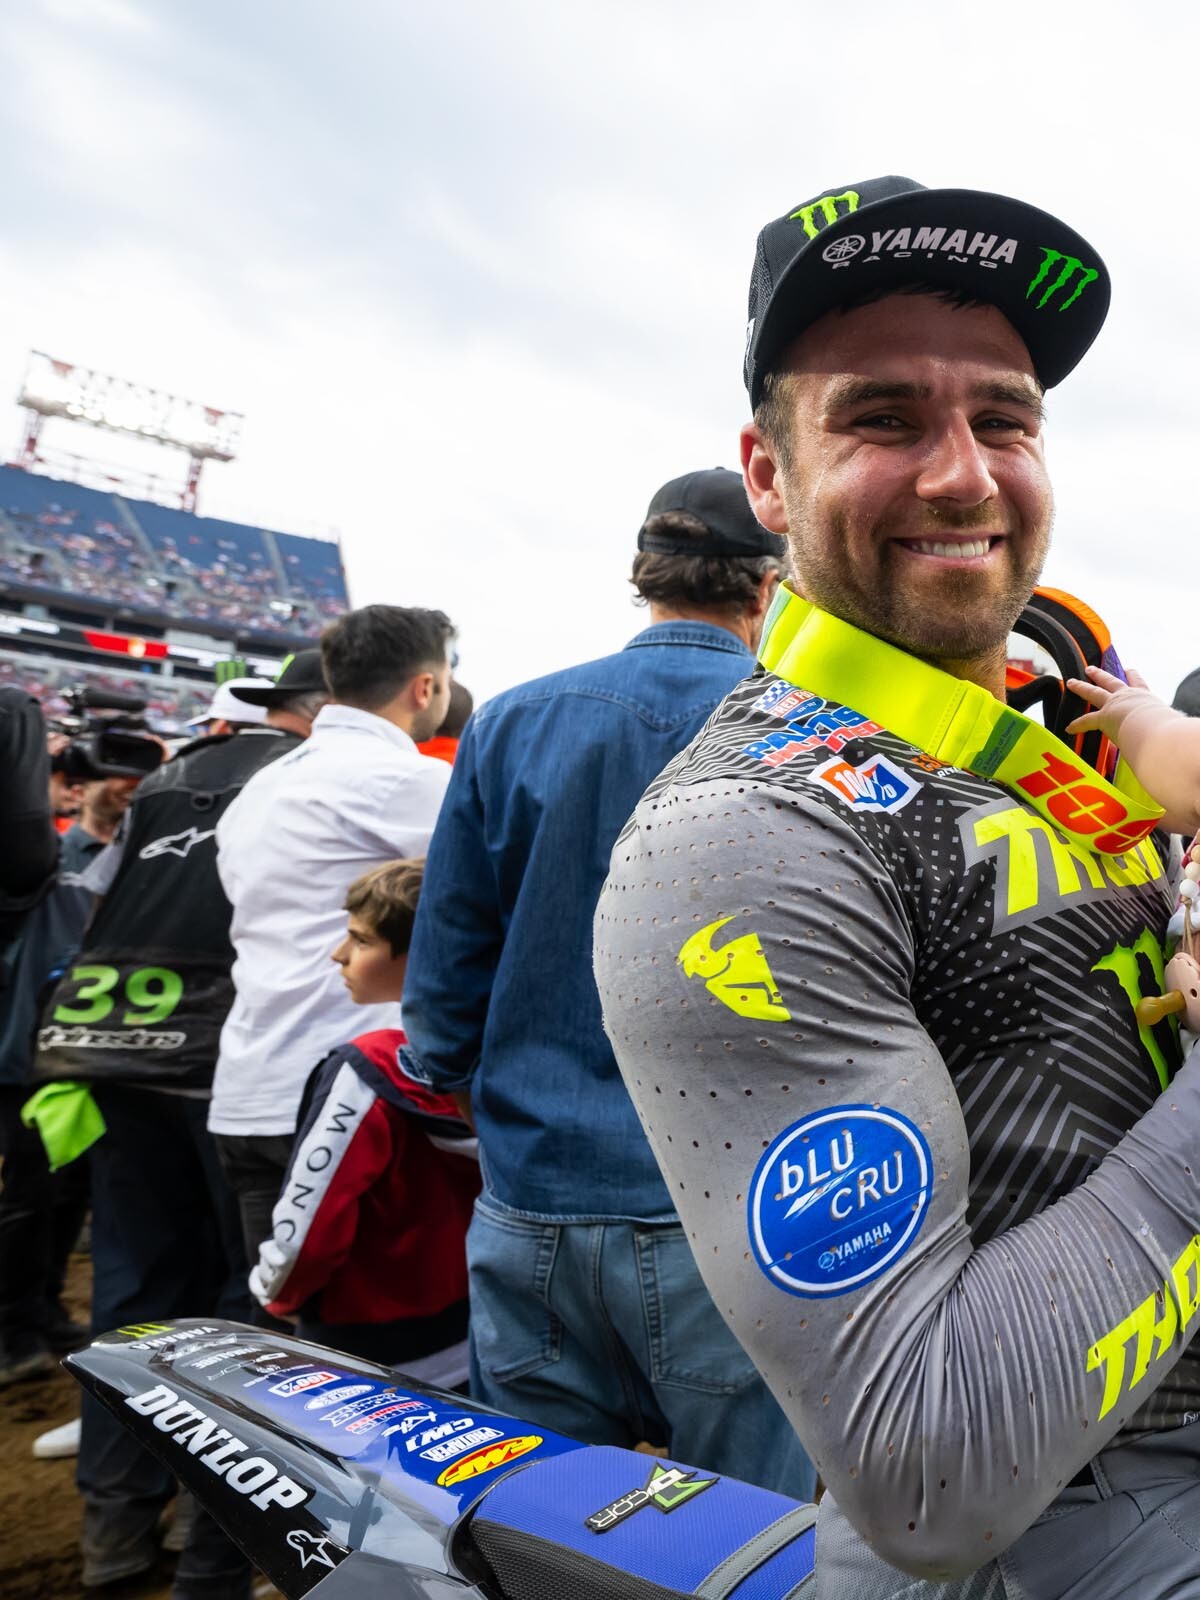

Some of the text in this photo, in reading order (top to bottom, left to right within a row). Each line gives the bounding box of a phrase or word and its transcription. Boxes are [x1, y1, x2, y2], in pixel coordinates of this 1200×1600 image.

[832, 252, 999, 270] RACING
[870, 227, 1019, 265] YAMAHA
[54, 965, 184, 1025] 39
[830, 1150, 904, 1220] CRU
[835, 1222, 893, 1260] YAMAHA
[281, 1372, 330, 1394] 100%
[125, 1384, 308, 1511] DUNLOP
[426, 1427, 498, 1462] PROTAPER
[444, 1435, 538, 1487] FMF
